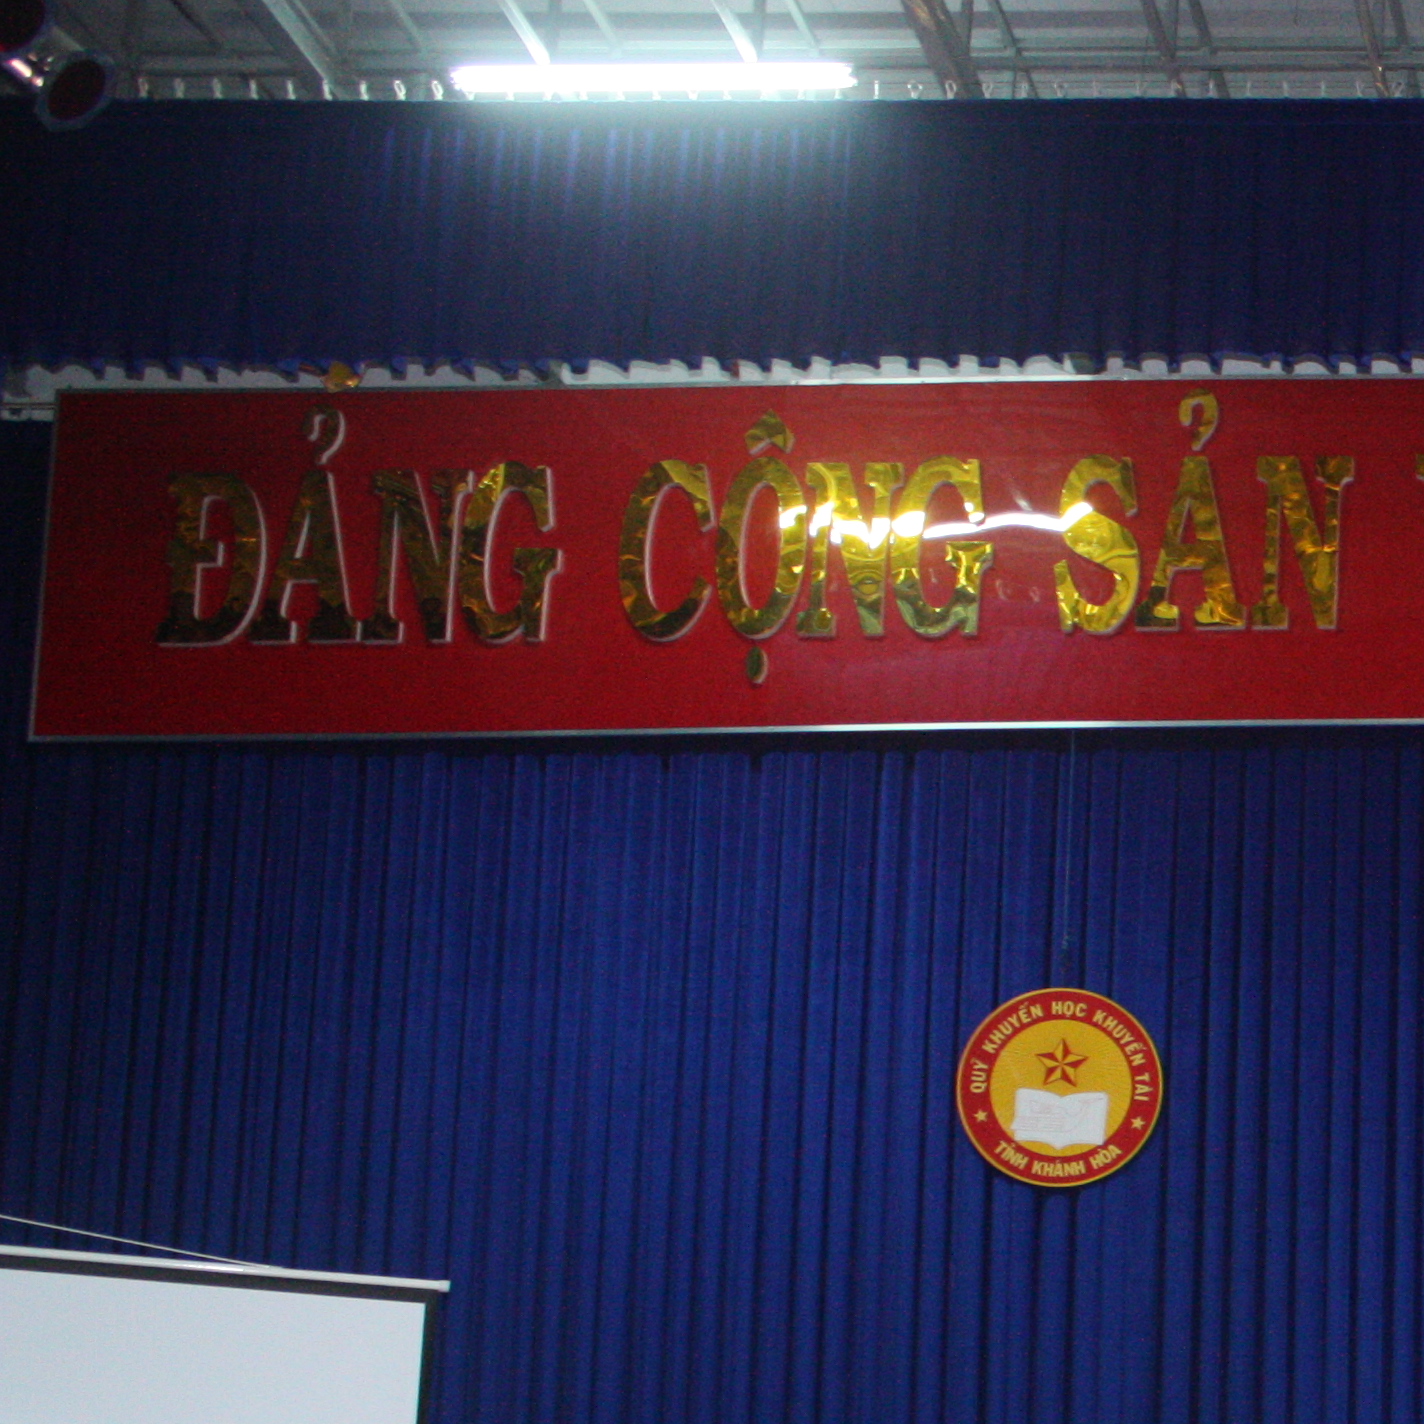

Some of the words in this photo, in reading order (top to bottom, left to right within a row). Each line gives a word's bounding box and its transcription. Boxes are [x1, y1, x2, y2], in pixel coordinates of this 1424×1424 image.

[155, 405, 562, 648] ĐẢNG
[617, 412, 994, 687] CỘNG
[1054, 391, 1355, 634] SẢN
[970, 1056, 990, 1094] QUỸ
[981, 1001, 1044, 1054] KHUYẾN
[1051, 1001, 1088, 1018] HỌC
[1092, 1008, 1146, 1067] KHUYẾN
[1133, 1071, 1153, 1101] TÀI
[994, 1140, 1029, 1170] TỈNH
[1031, 1160, 1087, 1178] KHÁNH
[1090, 1144, 1123, 1170] HÒA
